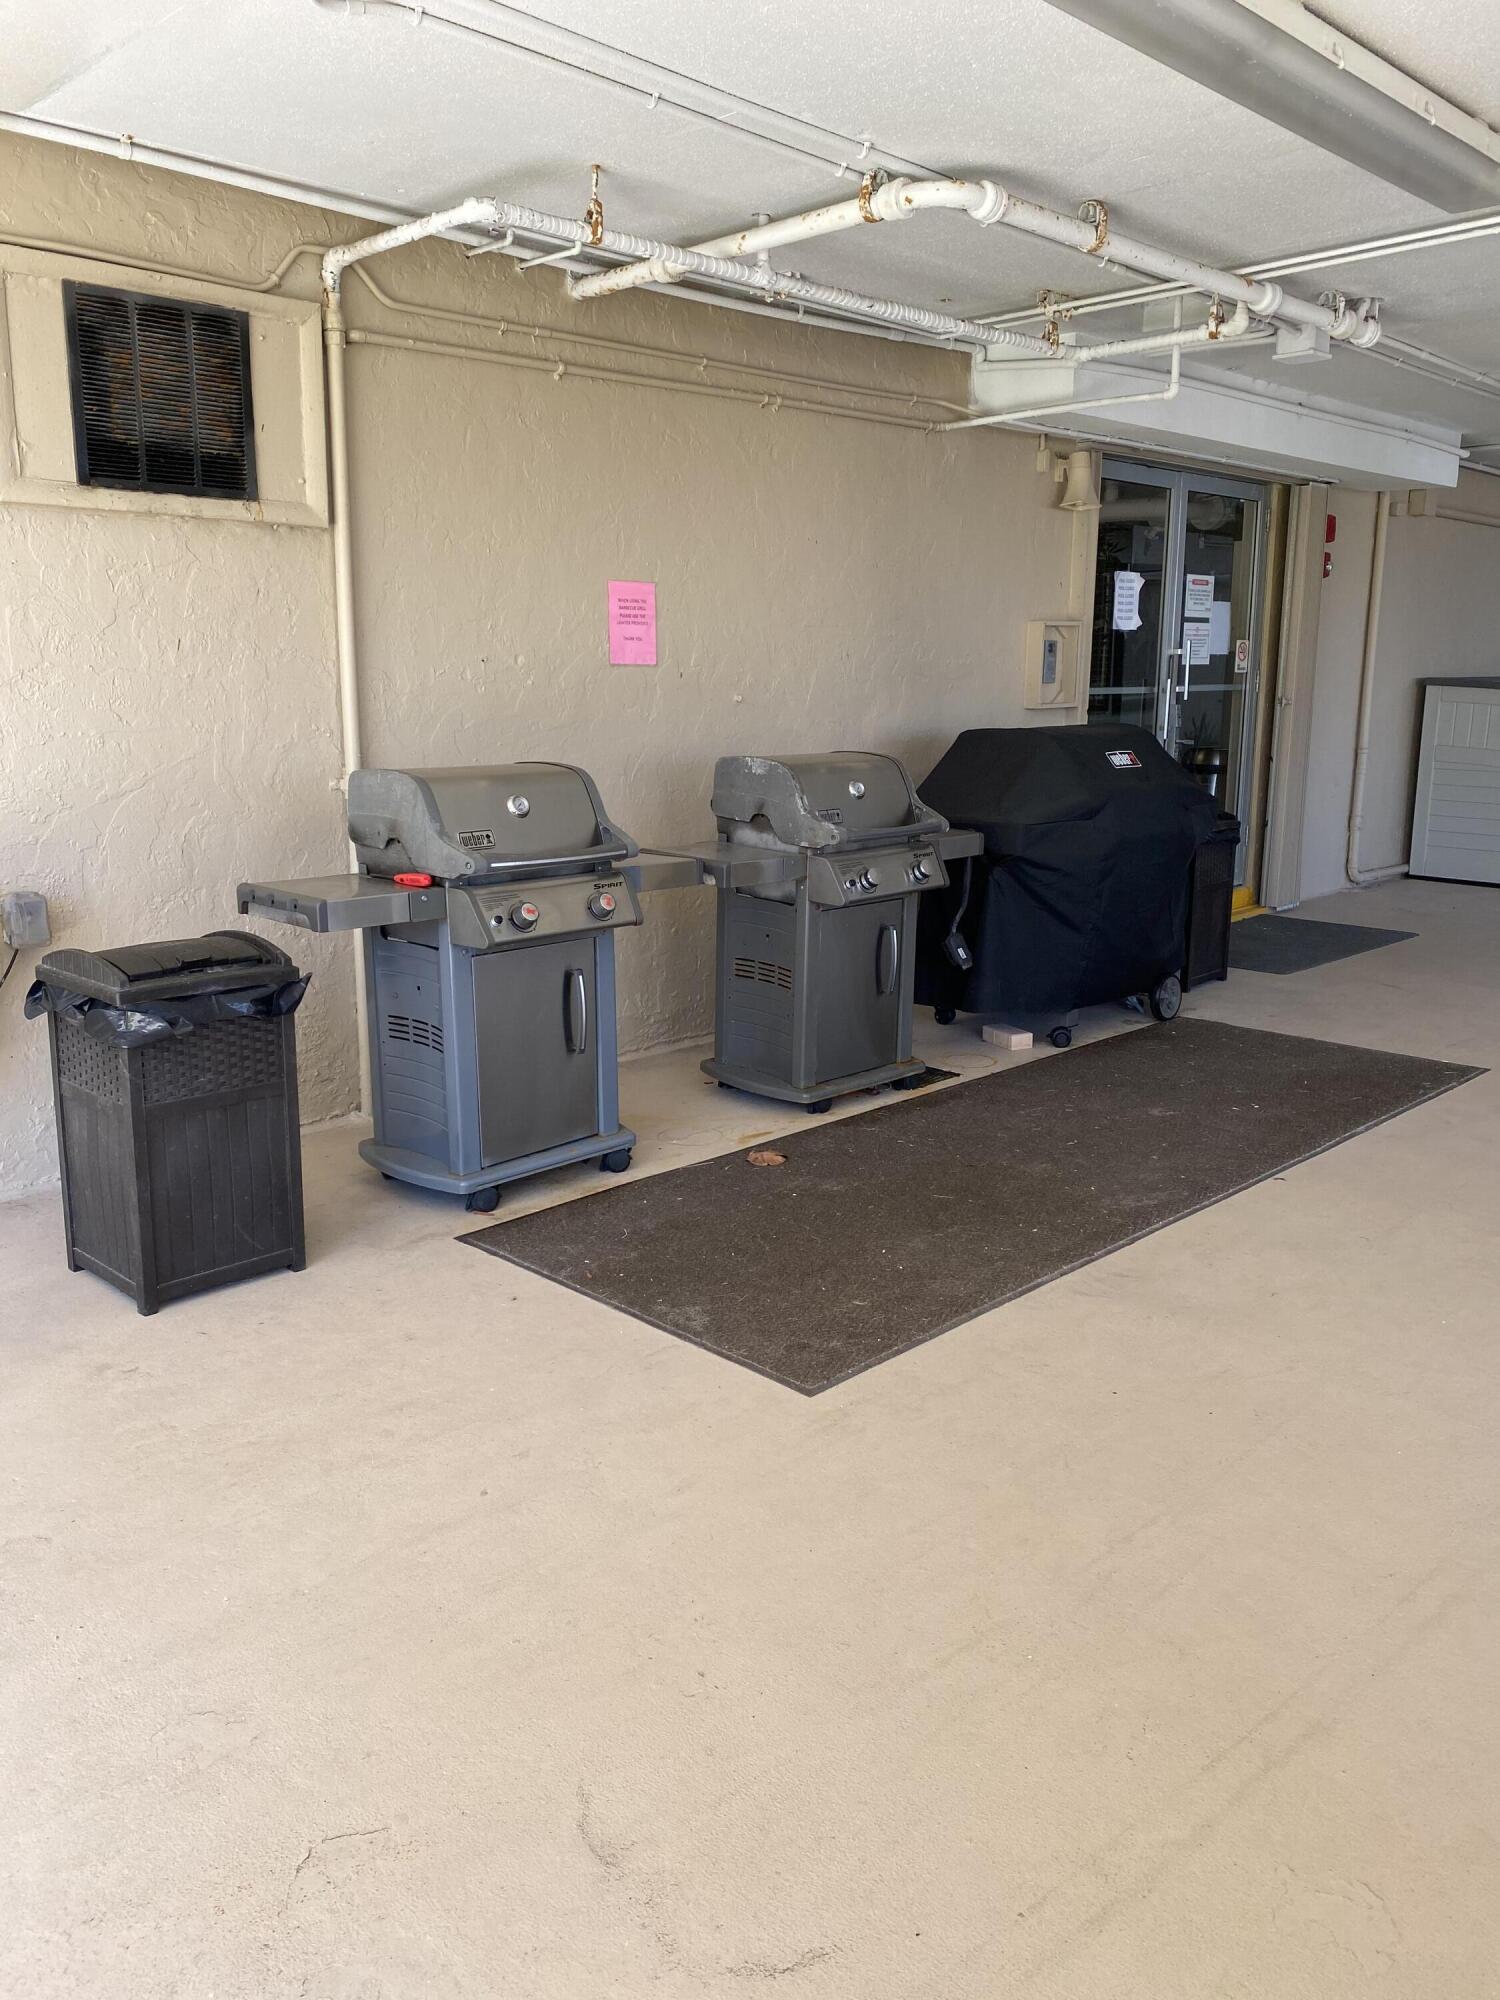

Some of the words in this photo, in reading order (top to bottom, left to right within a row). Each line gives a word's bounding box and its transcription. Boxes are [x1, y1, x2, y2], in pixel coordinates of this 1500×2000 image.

[1109, 752, 1133, 766] weber
[460, 832, 486, 848] weber
[593, 881, 624, 890] SPIRIT
